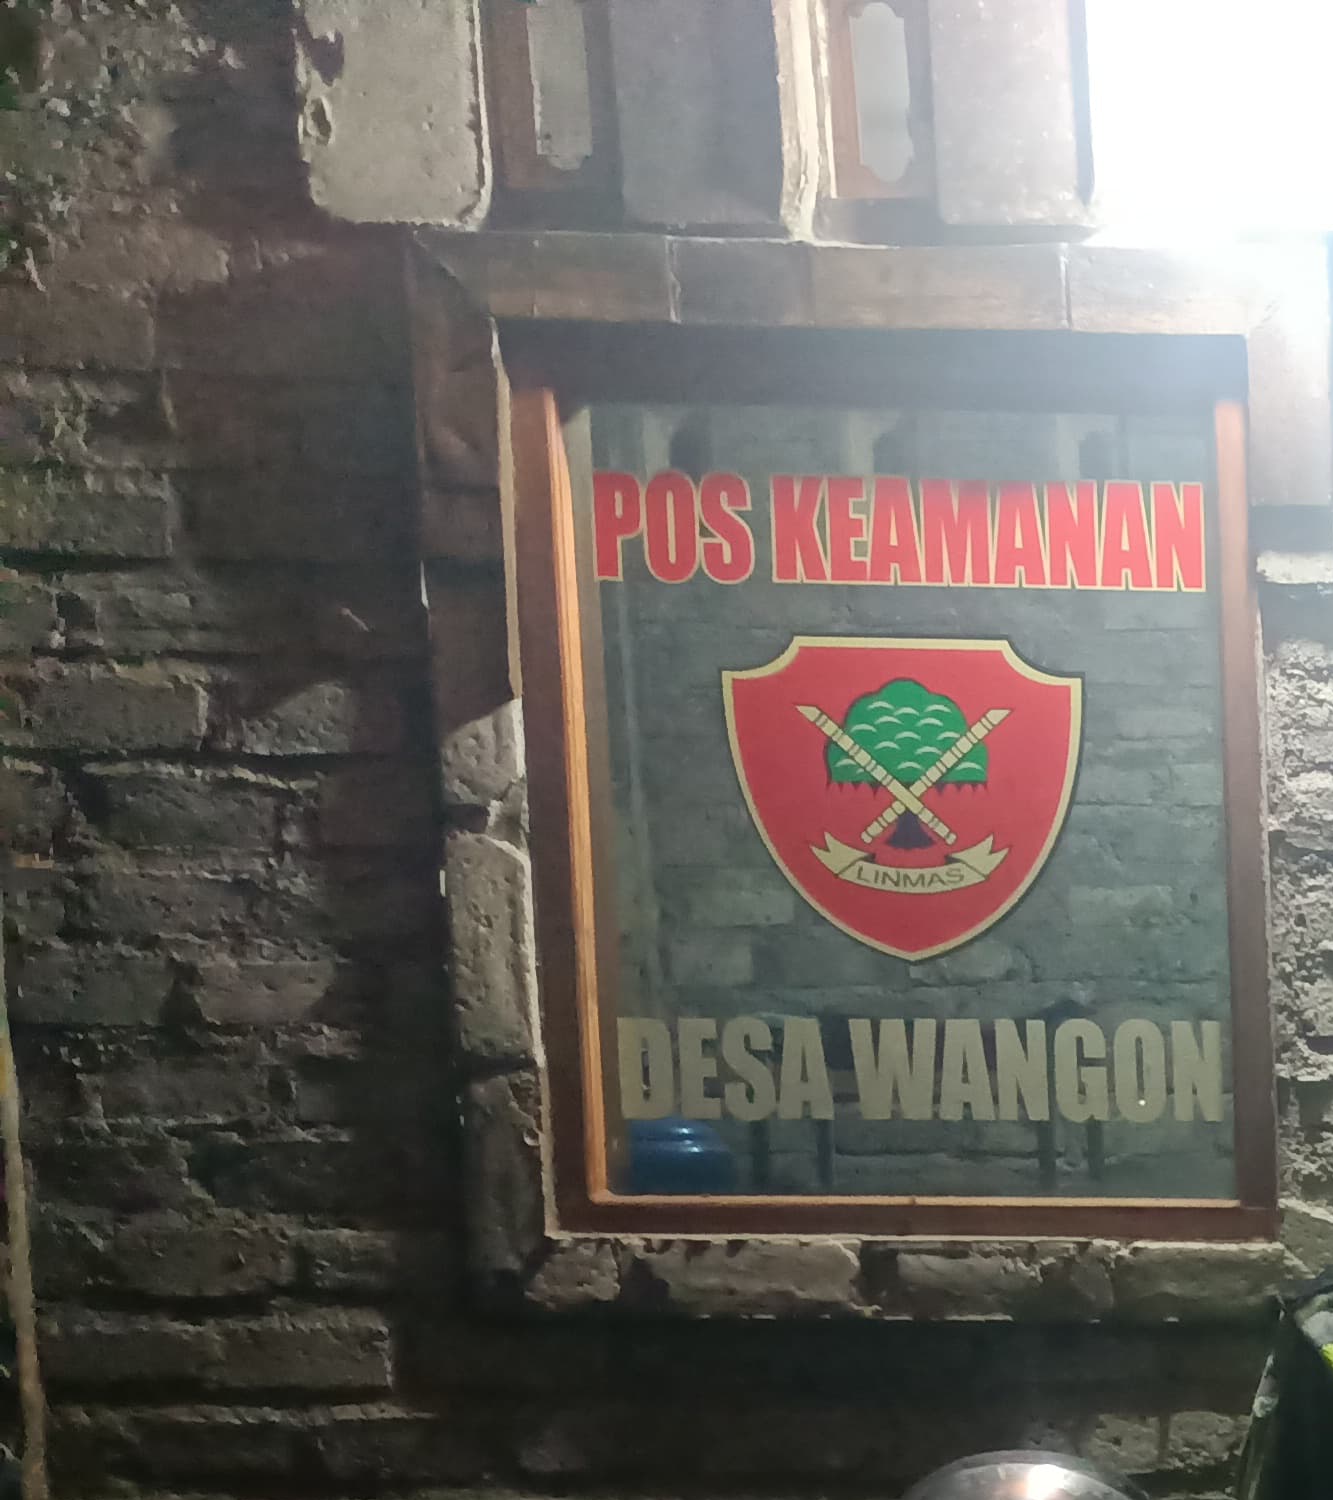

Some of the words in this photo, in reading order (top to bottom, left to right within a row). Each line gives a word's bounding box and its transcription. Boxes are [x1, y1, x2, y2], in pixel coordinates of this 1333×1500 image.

[592, 470, 754, 584] POS
[771, 475, 1206, 592] KEAMANAN
[856, 864, 965, 888] LINMAS
[617, 1015, 834, 1121] DESA
[847, 1018, 1225, 1122] WANGON
